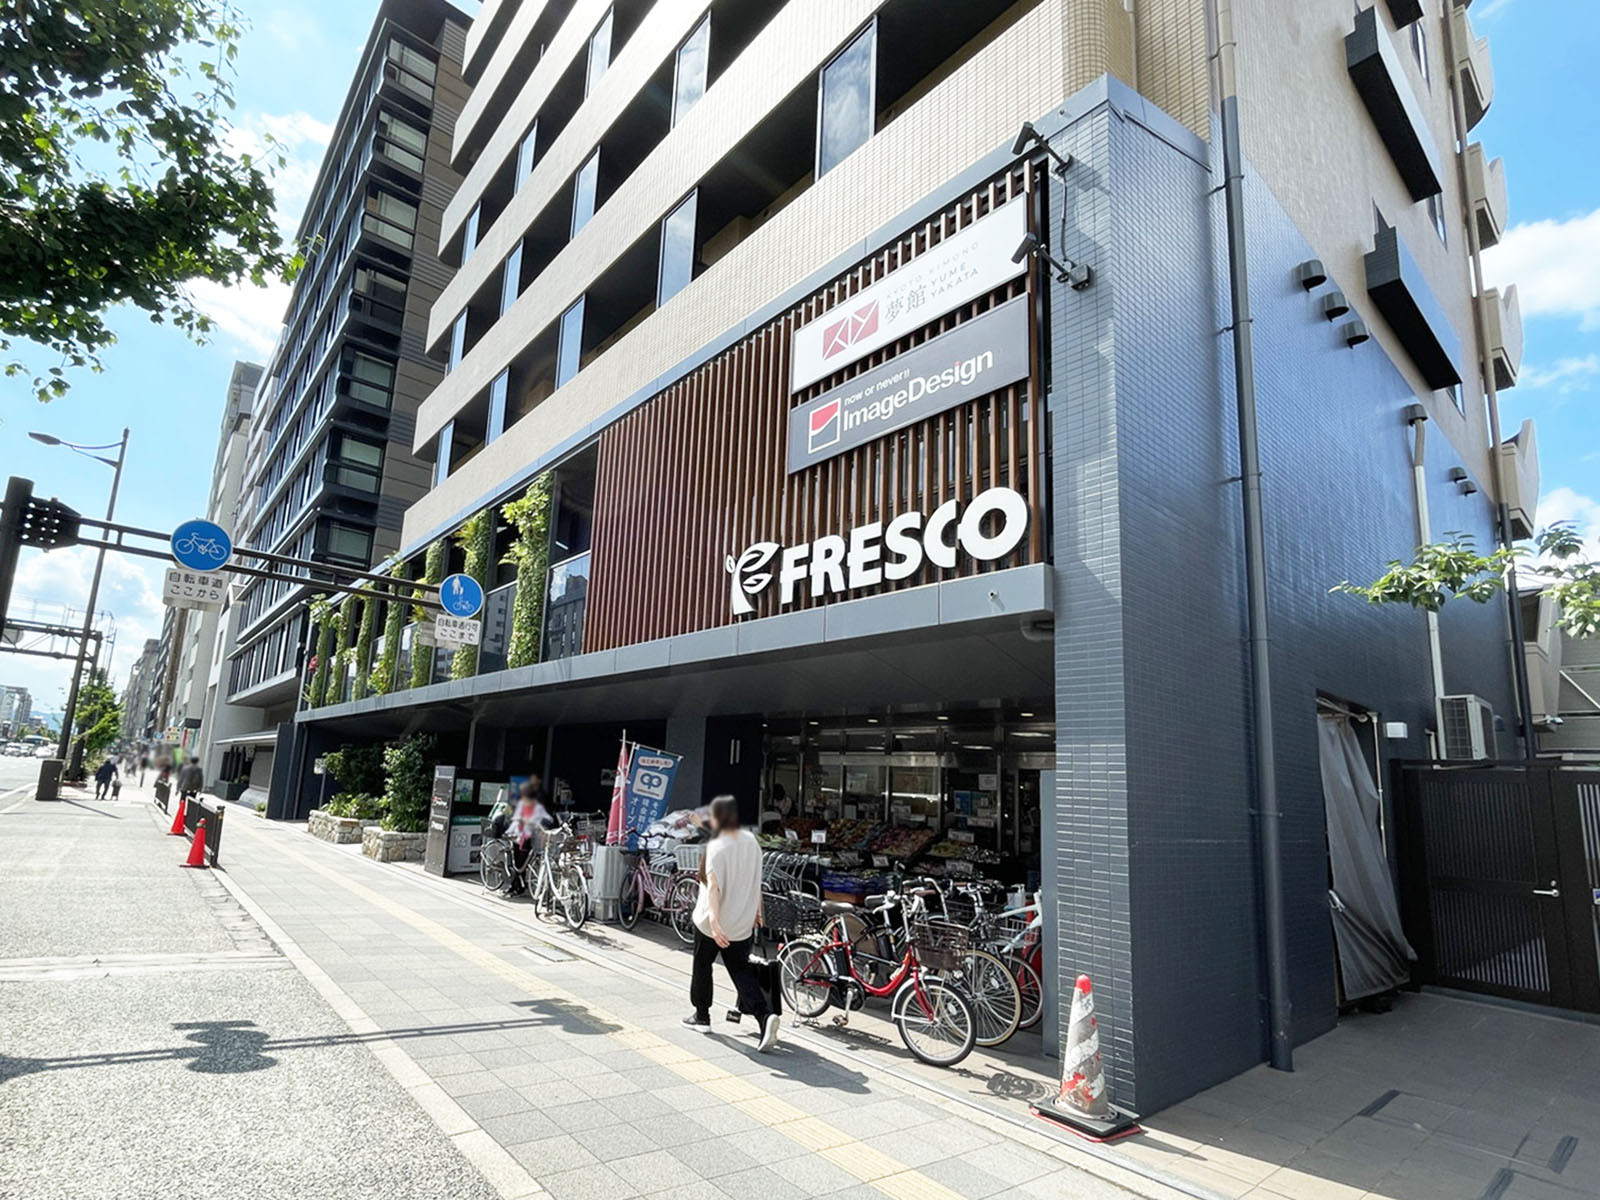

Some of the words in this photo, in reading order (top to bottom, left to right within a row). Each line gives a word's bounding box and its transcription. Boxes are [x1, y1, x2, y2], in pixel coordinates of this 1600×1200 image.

[931, 261, 966, 286] YUME
[931, 267, 979, 298] YAKATA
[843, 350, 994, 432] ImageDesign
[844, 390, 863, 406] now
[865, 384, 875, 396] or
[780, 487, 1028, 605] FRESCO
[169, 572, 223, 588] 自転車道
[170, 584, 219, 600] ここから
[440, 628, 475, 641] ここまで
